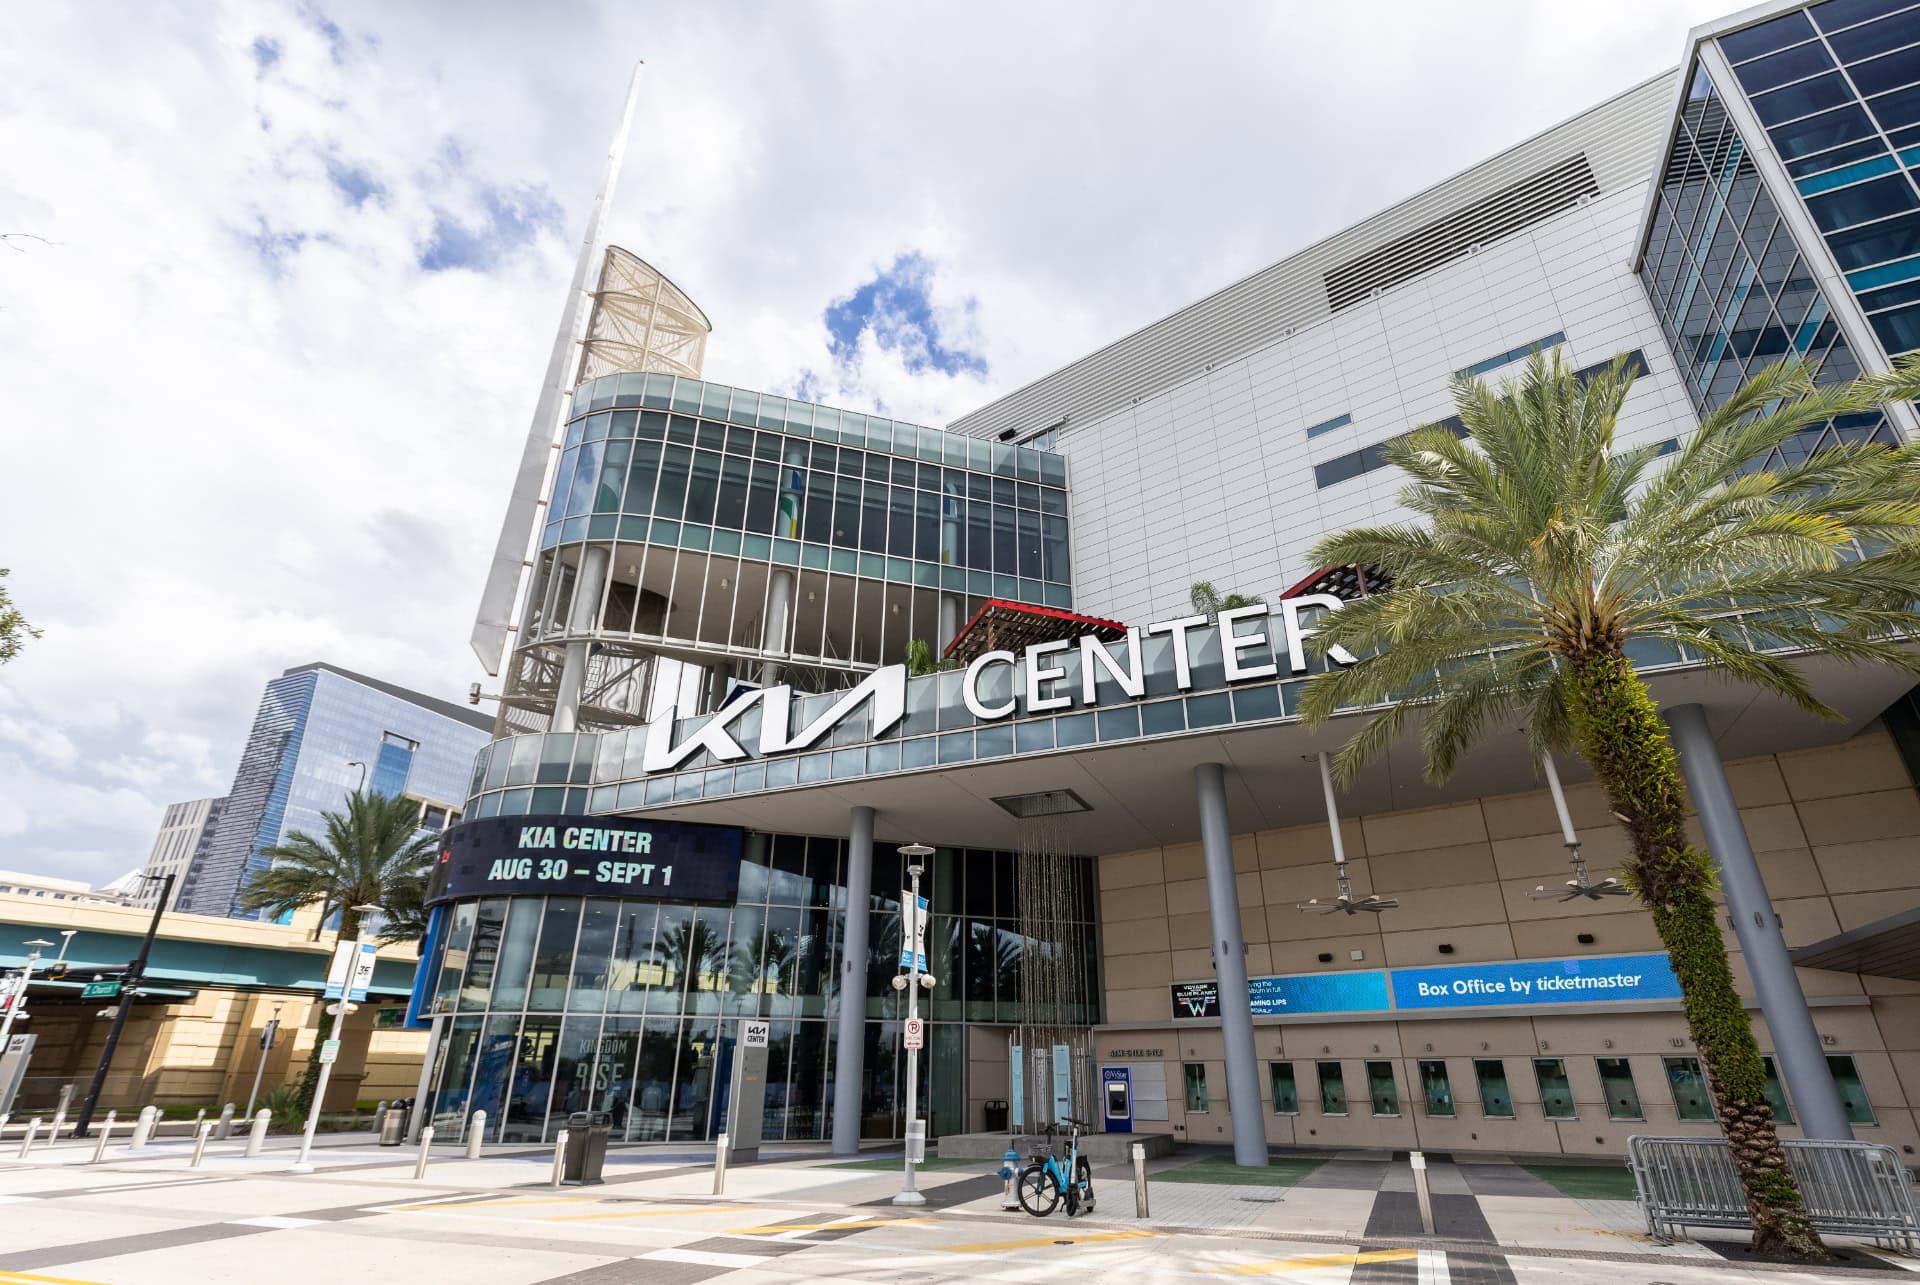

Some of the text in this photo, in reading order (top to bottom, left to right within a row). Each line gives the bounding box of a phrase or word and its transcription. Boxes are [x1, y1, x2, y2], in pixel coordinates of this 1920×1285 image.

[642, 593, 1360, 774] KIA CENTER
[518, 826, 653, 854] KIA CENTER
[488, 858, 533, 881] AUG
[537, 858, 569, 881] 30
[595, 861, 655, 885] SEPT
[662, 865, 673, 886] 1
[1418, 973, 1642, 997] Box Office by ticketmaster
[748, 1026, 766, 1035] KIA
[580, 1039, 627, 1054] KINGDOM
